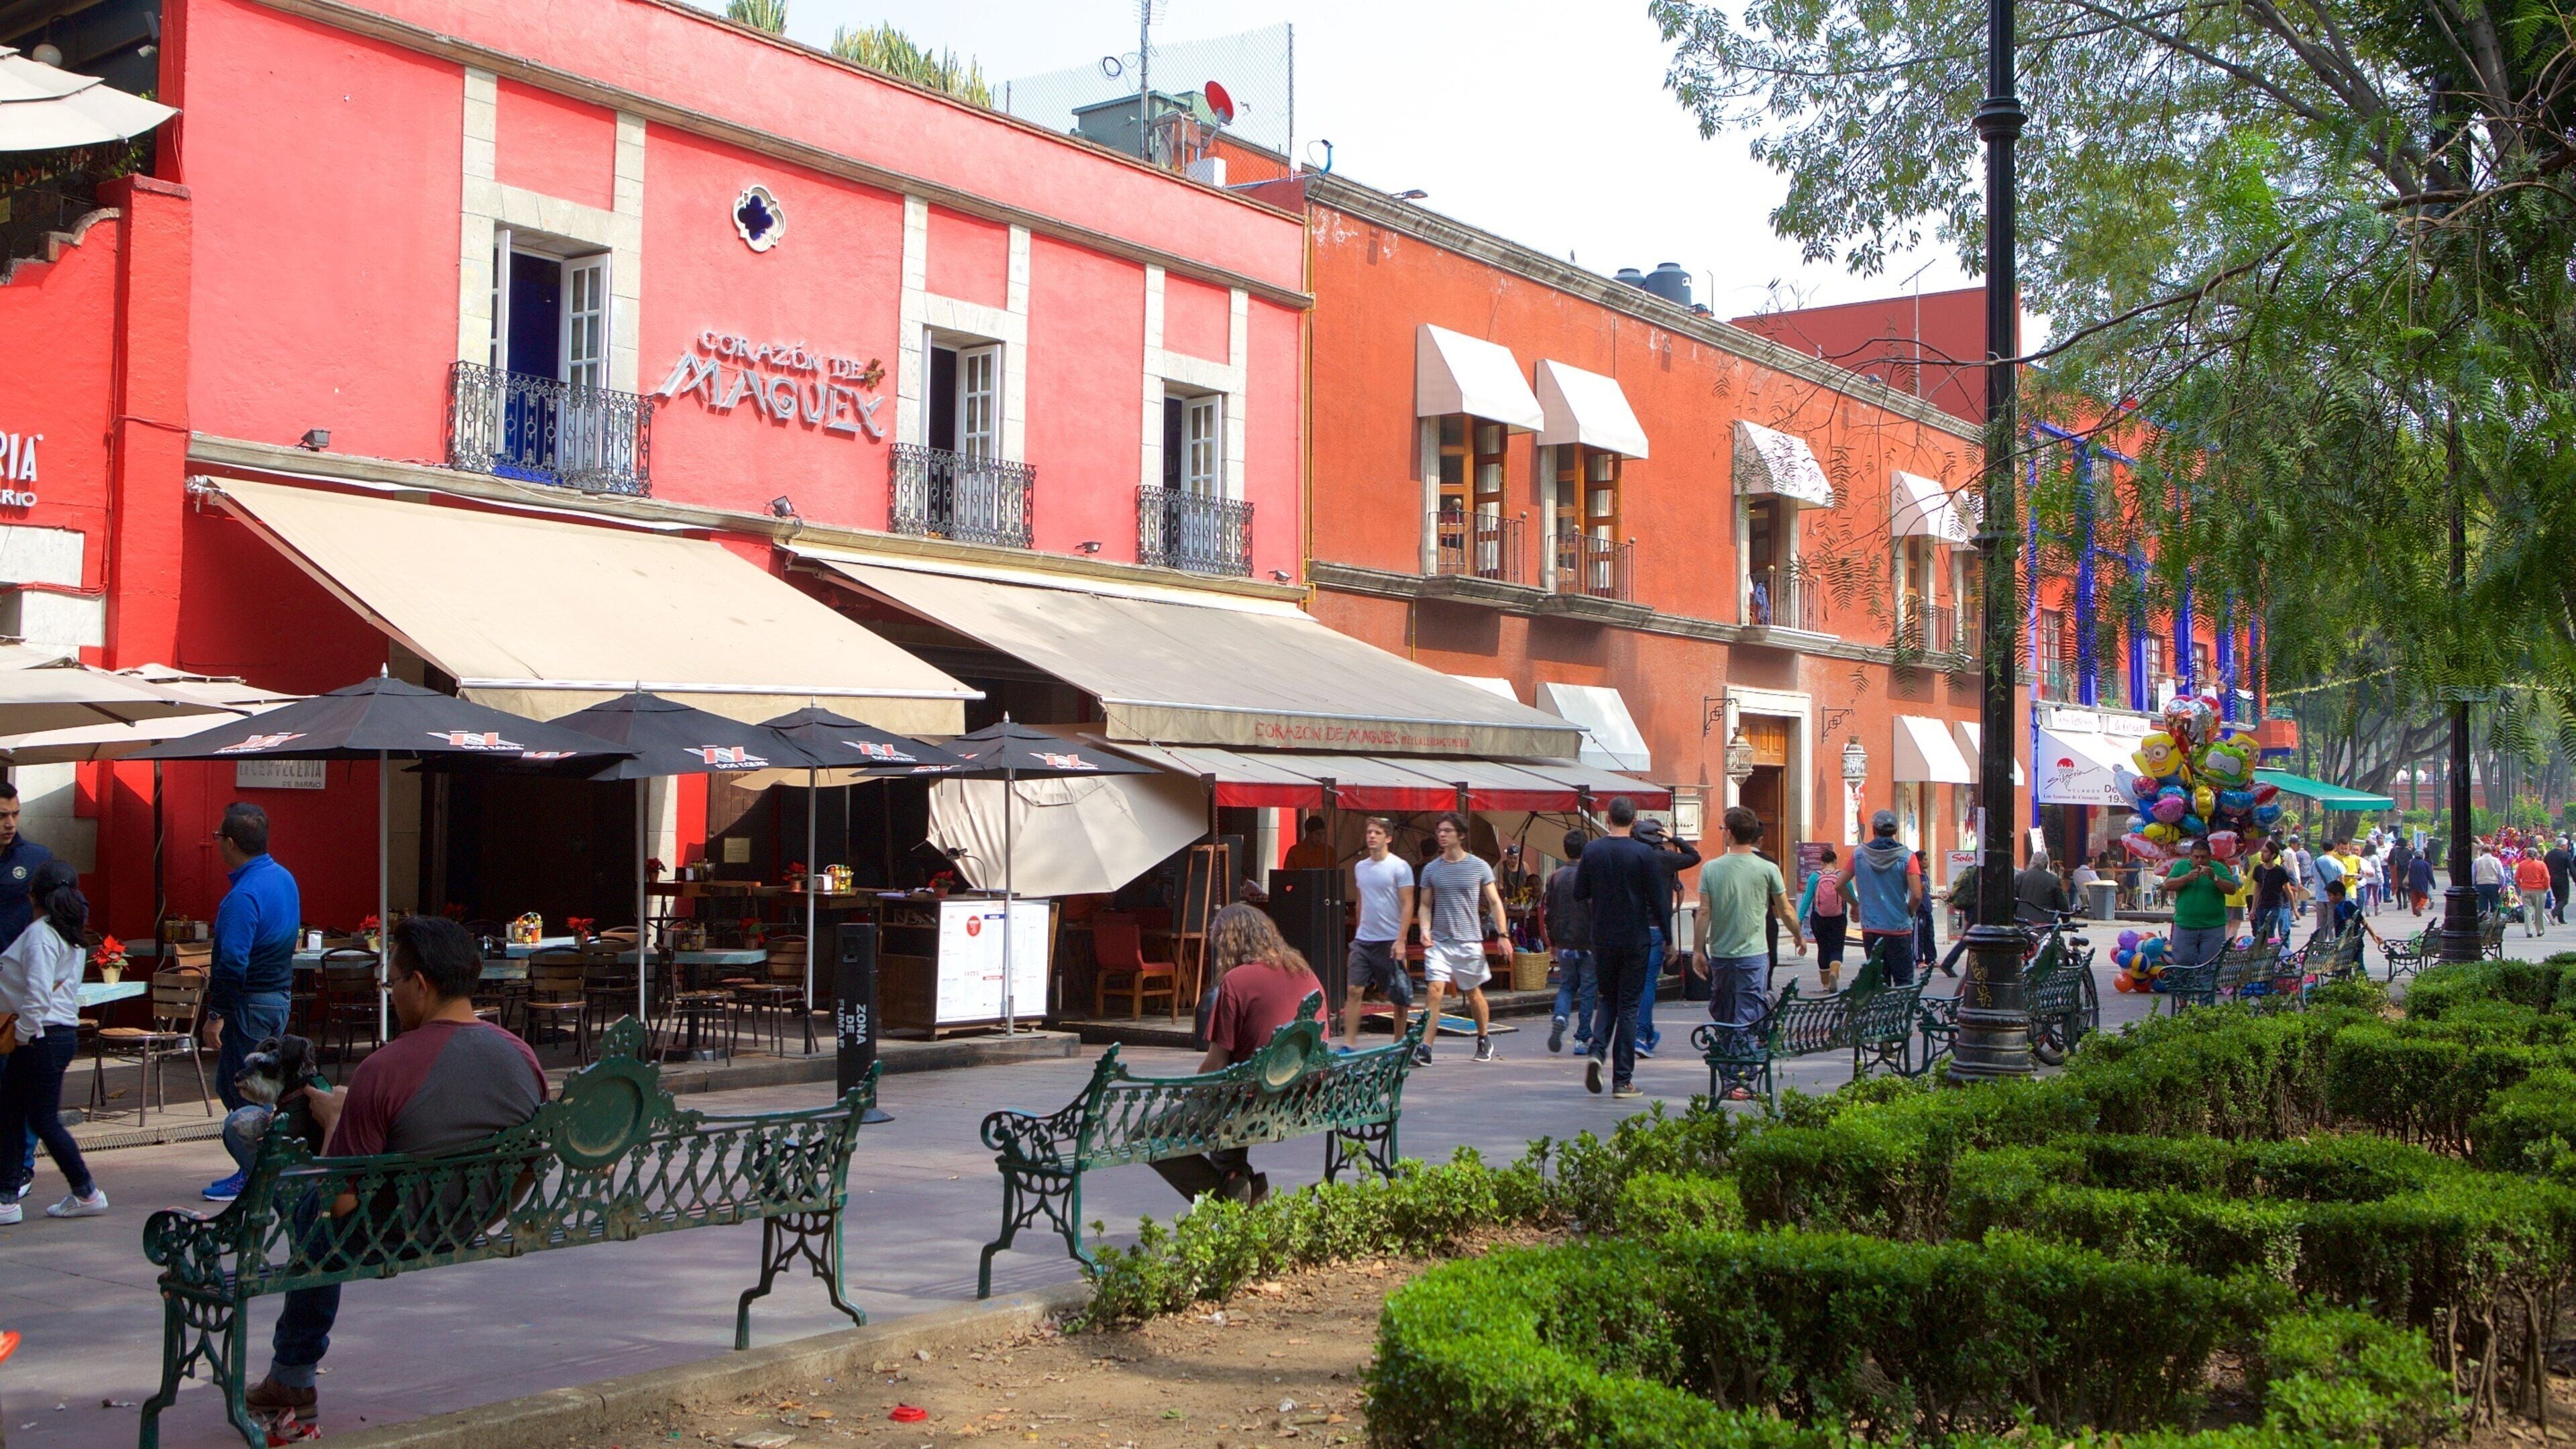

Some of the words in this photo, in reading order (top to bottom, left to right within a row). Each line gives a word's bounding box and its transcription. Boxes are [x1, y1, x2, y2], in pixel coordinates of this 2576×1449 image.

[698, 329, 824, 373] CORAZÓN
[829, 354, 865, 380] DE
[651, 350, 887, 437] MAGUEY
[1254, 721, 1321, 741] CORAZÓN
[1326, 726, 1344, 741] DE
[837, 998, 845, 1049] FUMAR
[846, 1014, 855, 1034] DE
[856, 1004, 867, 1045] ZONA
